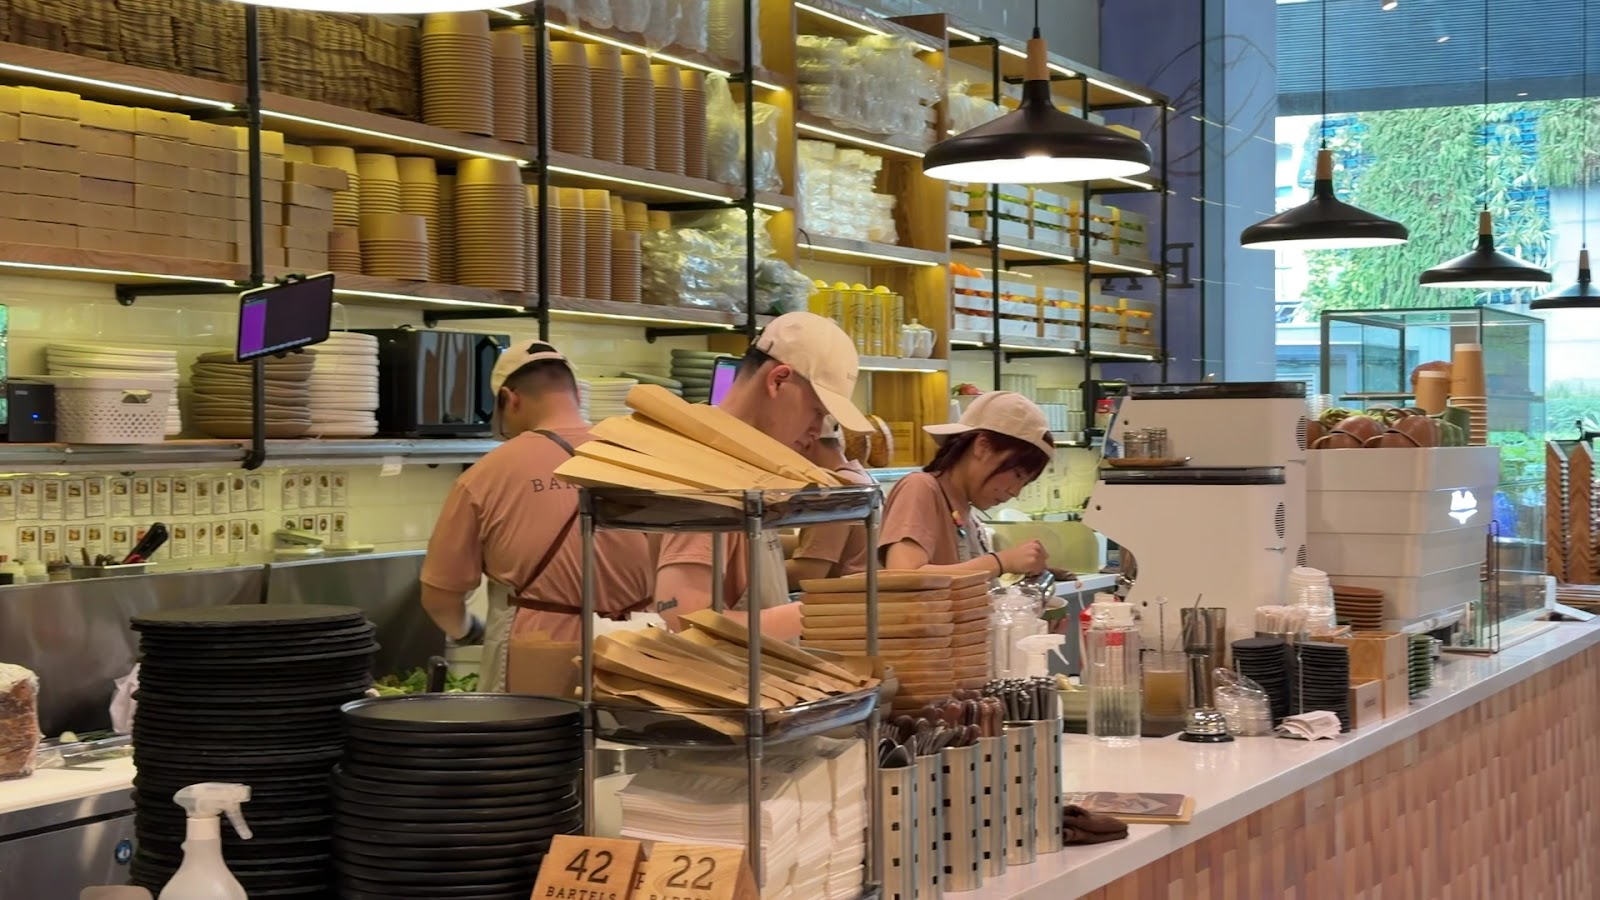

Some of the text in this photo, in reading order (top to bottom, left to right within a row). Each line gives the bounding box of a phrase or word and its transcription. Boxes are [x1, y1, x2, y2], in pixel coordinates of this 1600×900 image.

[565, 849, 613, 884] 42
[666, 855, 716, 891] 22
[545, 886, 617, 900] BARTELS
